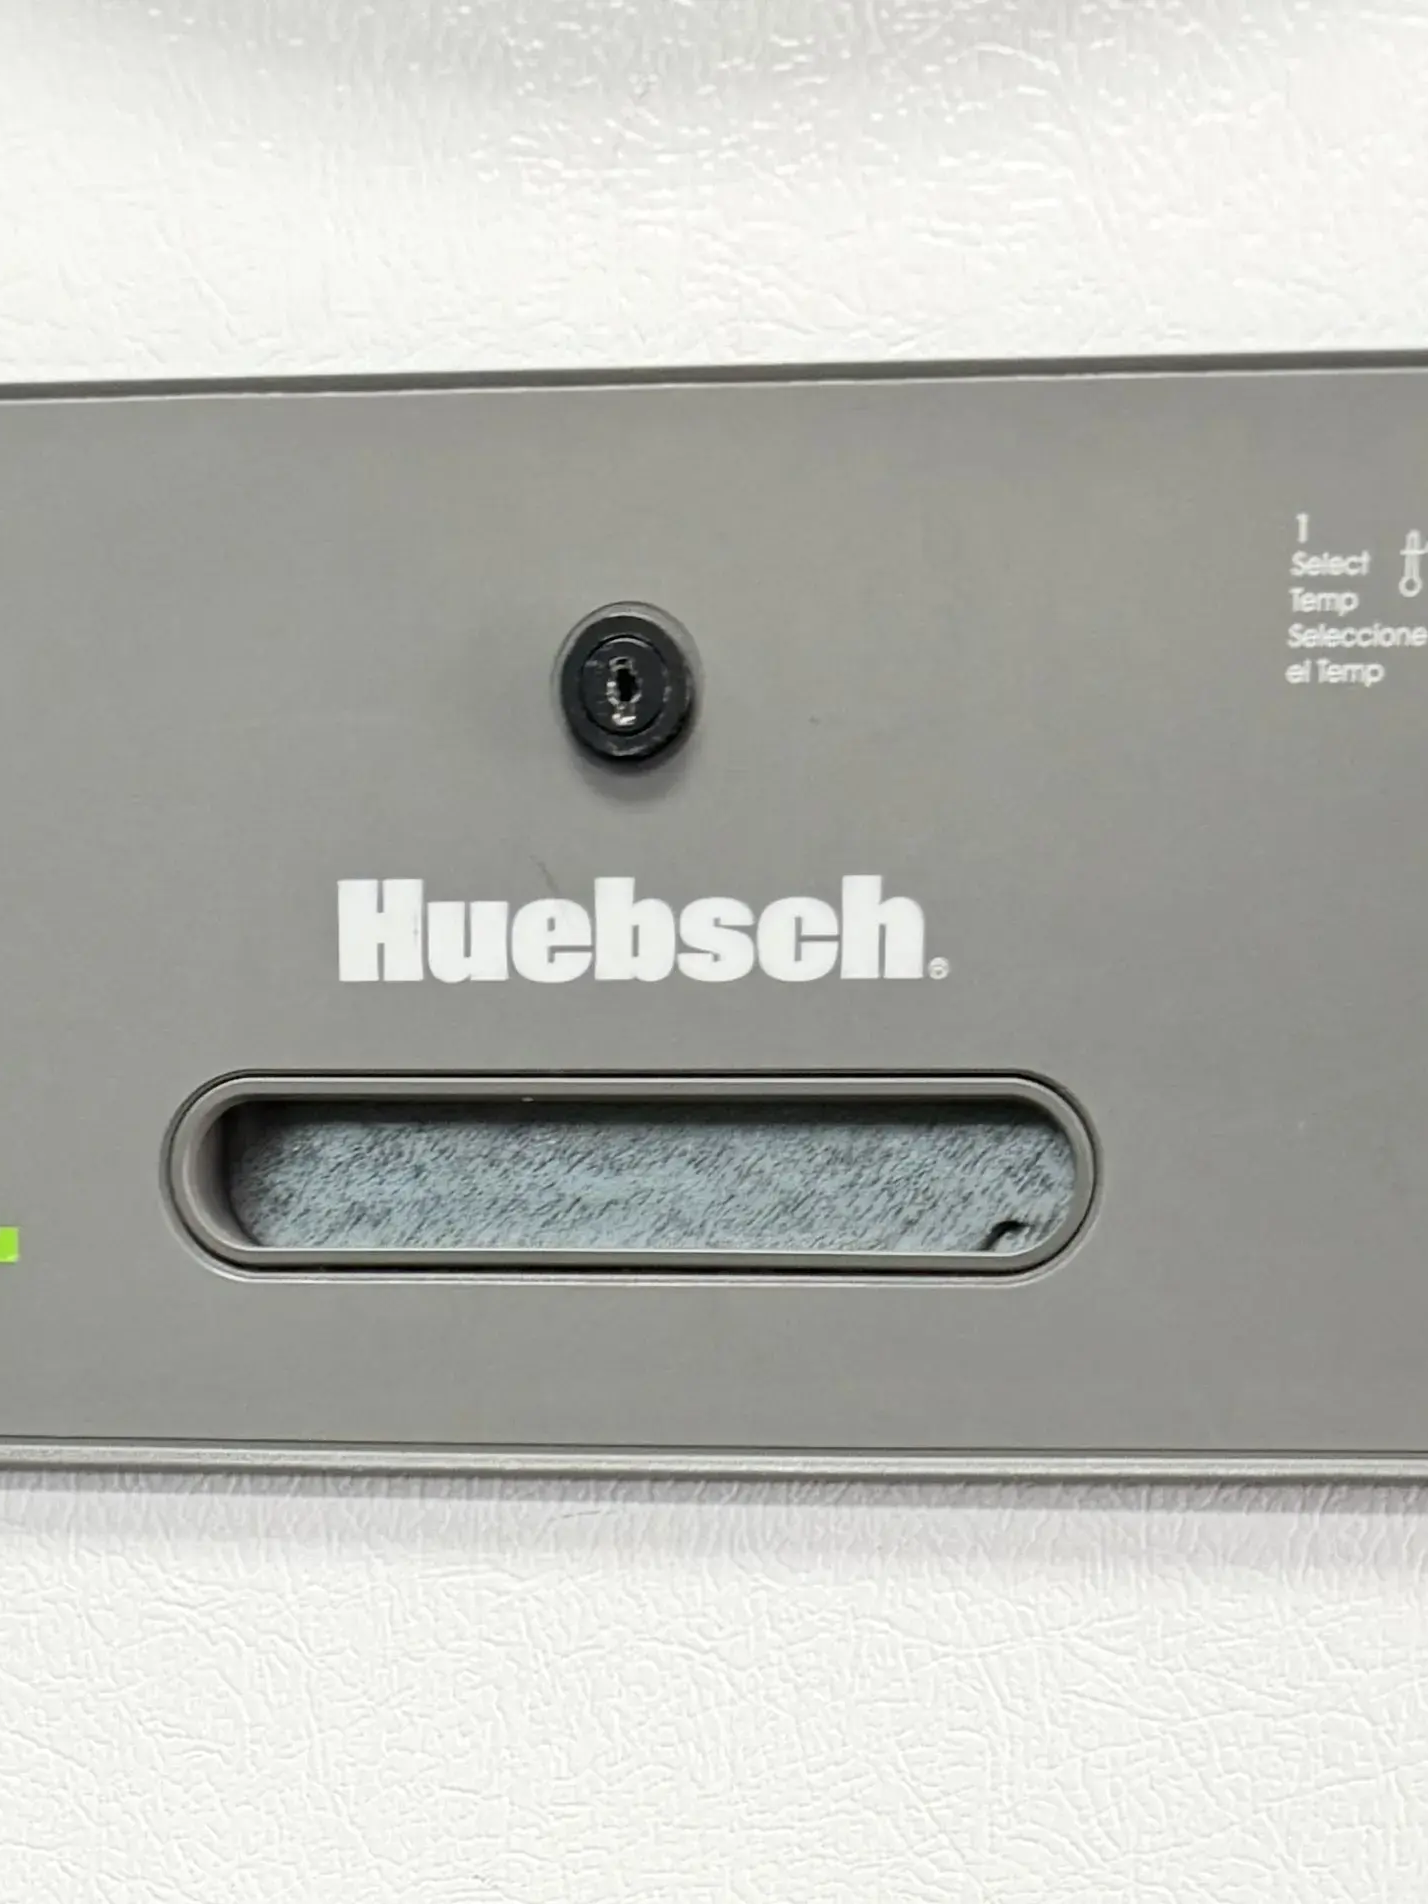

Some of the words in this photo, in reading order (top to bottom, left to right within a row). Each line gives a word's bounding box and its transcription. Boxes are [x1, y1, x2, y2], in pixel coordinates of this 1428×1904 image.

[1295, 513, 1310, 543] 1
[1289, 549, 1371, 576] Select
[1288, 587, 1360, 617] Temp
[1287, 622, 1428, 648] Seleccione
[1284, 658, 1312, 684] el
[1316, 658, 1385, 688] Temp
